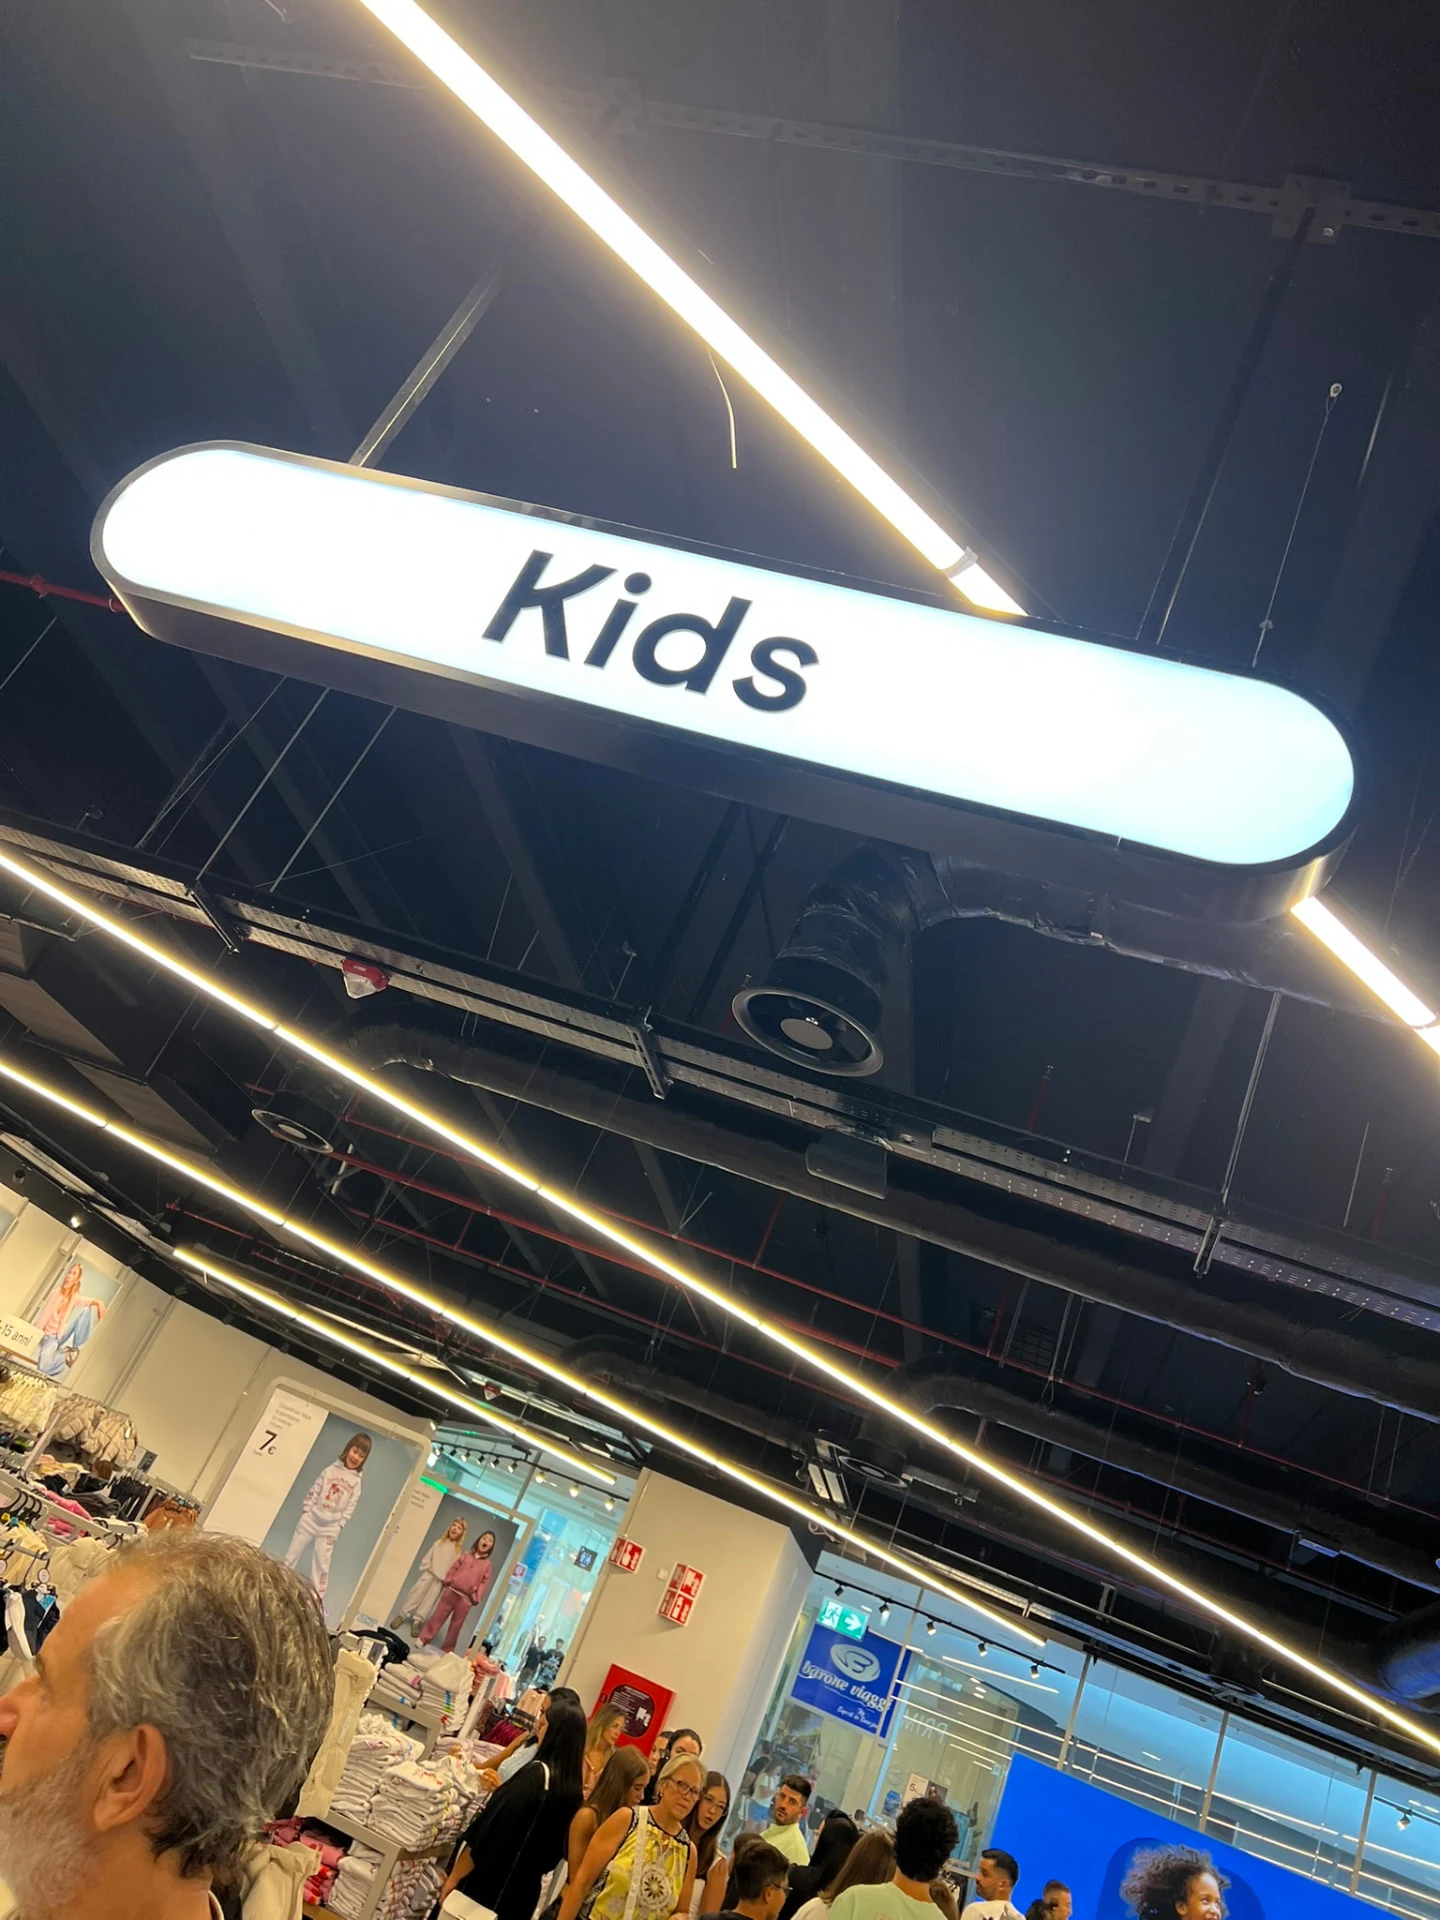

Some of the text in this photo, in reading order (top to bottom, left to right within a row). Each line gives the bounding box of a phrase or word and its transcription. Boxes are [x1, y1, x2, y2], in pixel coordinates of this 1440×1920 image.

[482, 549, 819, 713] Kids
[11, 1331, 33, 1346] anni
[799, 1660, 849, 1691] barone
